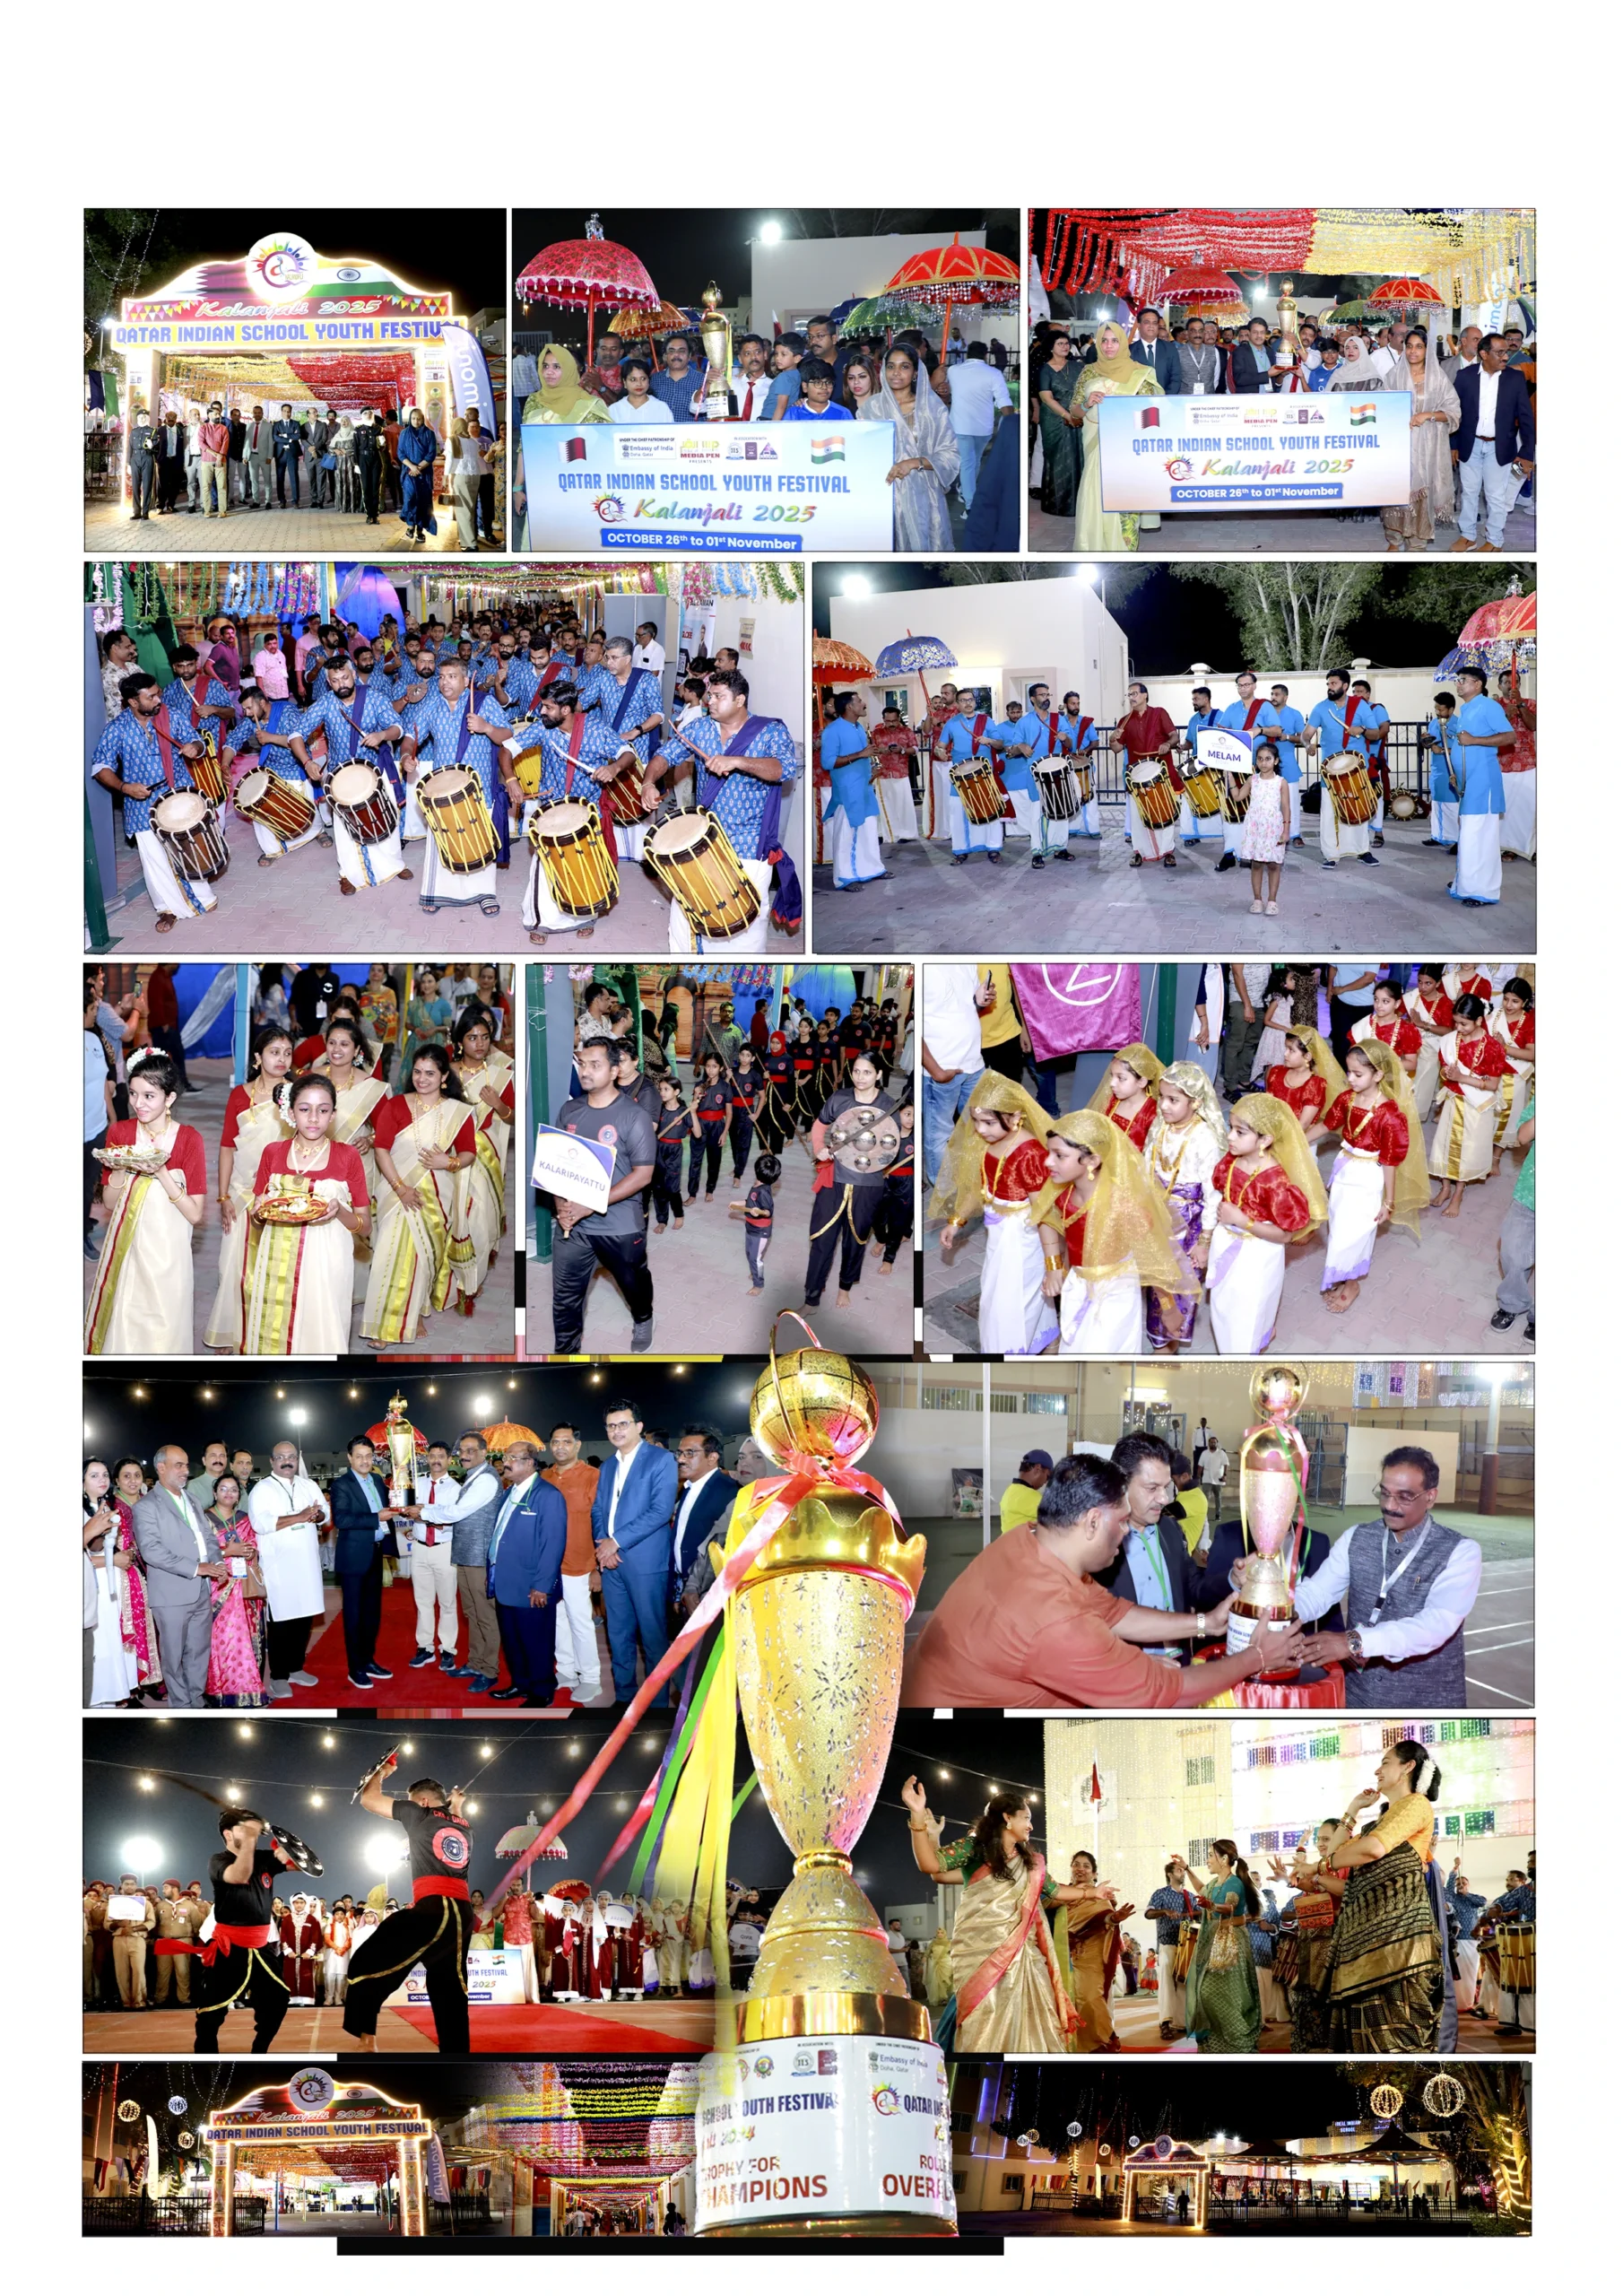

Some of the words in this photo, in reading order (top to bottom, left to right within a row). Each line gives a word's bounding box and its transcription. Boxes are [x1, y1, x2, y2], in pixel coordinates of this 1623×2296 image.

[195, 300, 308, 319] Kalanjali
[318, 300, 382, 314] 2025
[116, 326, 171, 344] QATAR
[178, 326, 235, 342] INDIAN
[241, 324, 309, 341] SCHOOL
[315, 322, 374, 340] YOUTH
[380, 320, 460, 339] FESTIV
[1133, 439, 1173, 456] QATAR
[1178, 438, 1221, 452] INDIAN
[1226, 437, 1274, 451] SCHOOL
[1280, 436, 1320, 450] YOUTH
[1324, 434, 1380, 448] FESTIVAL
[1202, 458, 1296, 481] Kalanjali
[1304, 458, 1355, 474] 2025
[559, 474, 602, 491] QATAR
[606, 474, 655, 490] INDIAN
[660, 474, 717, 491] SCHOOL
[723, 474, 772, 491] YOUTH
[777, 475, 850, 492] FESTIVAL
[1176, 490, 1227, 498] OCTOBER
[1229, 489, 1249, 498] 26th
[1251, 489, 1262, 497] to
[1264, 488, 1281, 497] 01st
[1282, 487, 1339, 496] November
[633, 498, 742, 526] Kalanjali
[752, 505, 817, 522] 2025
[607, 533, 663, 544] OCTOBER
[665, 535, 688, 545] 26th
[690, 536, 703, 545] to
[706, 536, 726, 546] 01st
[727, 537, 797, 550] November
[1208, 750, 1241, 762] MELAM
[539, 1161, 605, 1191] KALARIPAYATTU
[881, 2055, 907, 2066] Embassy
[335, 2109, 377, 2119] 2025
[742, 2096, 774, 2118] OUTH
[777, 2092, 838, 2112] FESTIVA
[904, 2094, 933, 2115] QATAR
[207, 2128, 241, 2140] QATAR
[246, 2126, 282, 2138] INDIAN
[286, 2126, 330, 2137] SCHOOL
[334, 2124, 372, 2135] YOUTH
[376, 2122, 428, 2135] FESTIVAL
[748, 2156, 780, 2174] FOR
[702, 2175, 828, 2208] HAMPIONS
